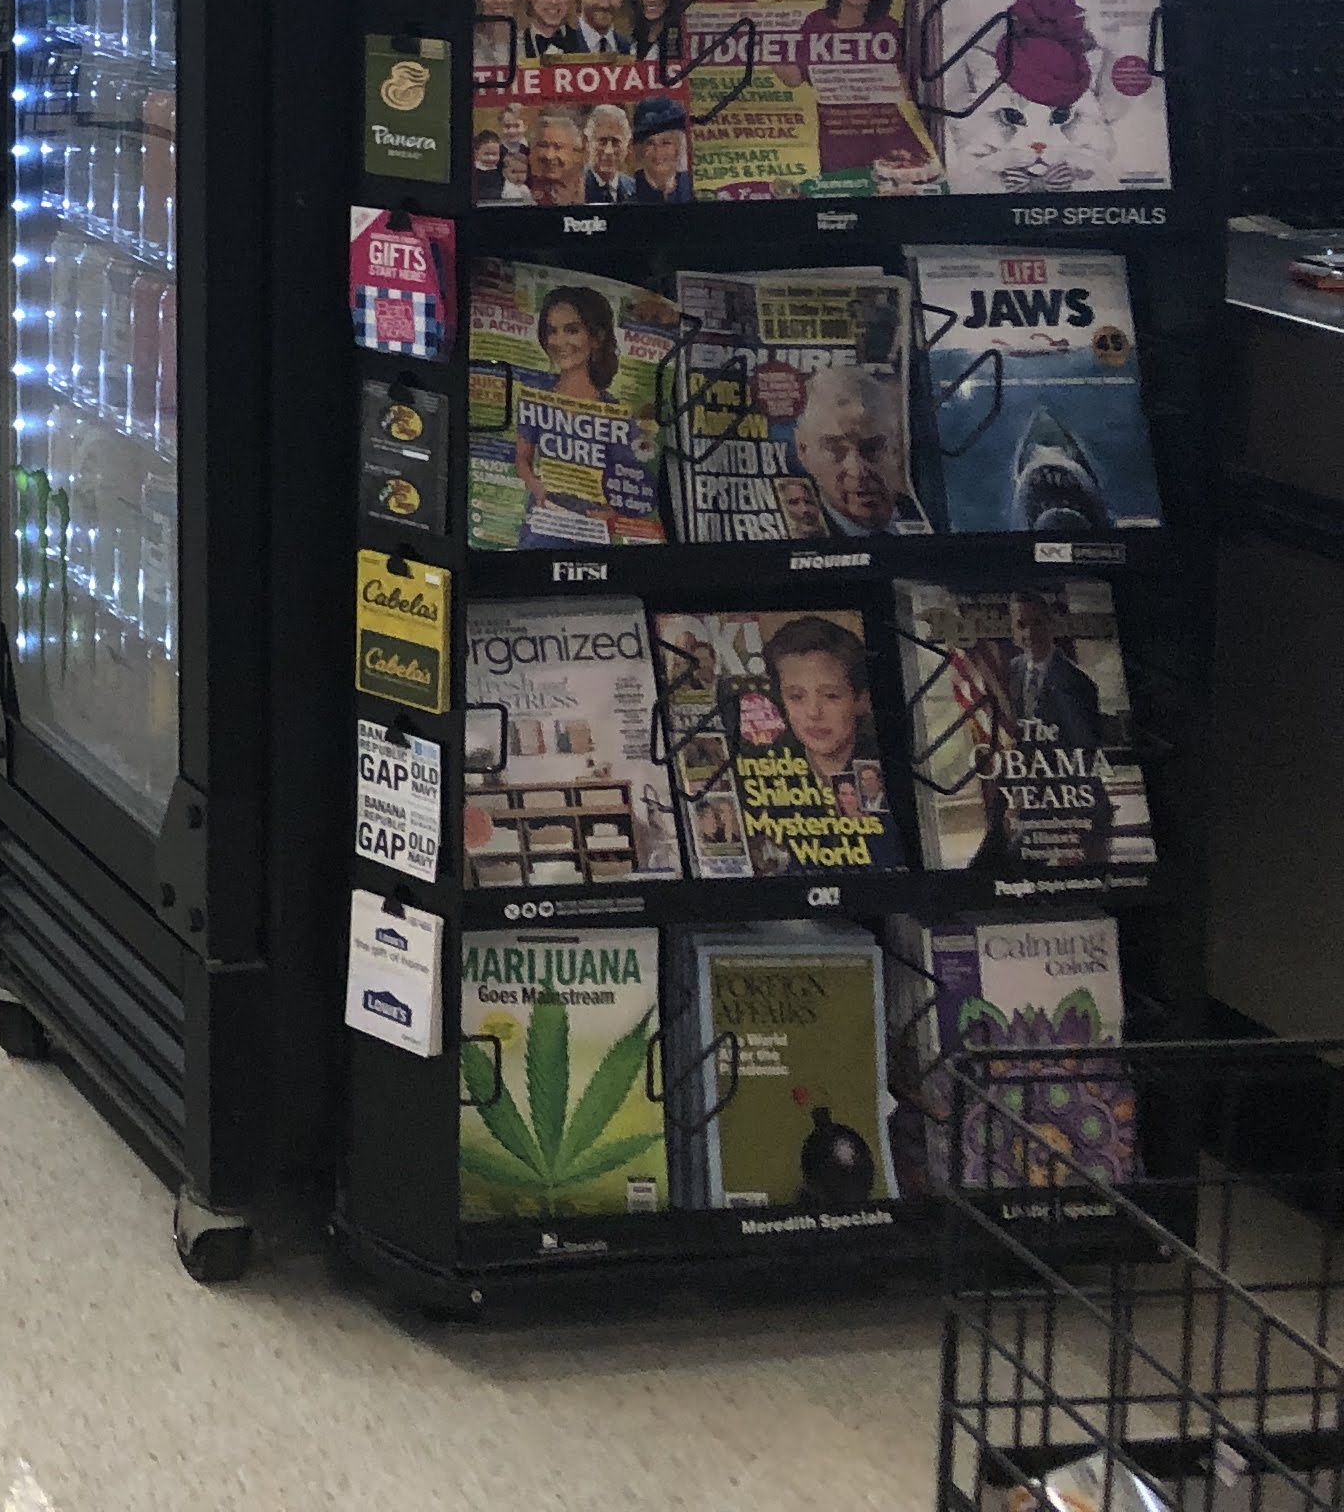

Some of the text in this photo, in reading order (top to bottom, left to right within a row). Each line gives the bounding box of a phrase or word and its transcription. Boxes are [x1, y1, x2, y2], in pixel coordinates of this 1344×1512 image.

[810, 31, 898, 61] KETO
[553, 64, 685, 92] ROYALS
[371, 124, 437, 151] Panera
[724, 126, 798, 140] PROZAC
[756, 162, 808, 178] FALLS
[563, 215, 608, 236] People
[1012, 206, 1167, 227] TISP SPECIALS
[368, 240, 428, 272] GIFTS
[1000, 258, 1048, 284] LIFE
[962, 287, 1096, 329] JAWS
[518, 401, 631, 446] HUNGER
[539, 432, 607, 469] CURE
[551, 561, 608, 582] First
[1017, 717, 1060, 743] The
[360, 752, 439, 791] GAP OLD
[736, 747, 810, 777] Inside
[969, 743, 1116, 781] OBAMA
[411, 778, 439, 800] NAVY
[745, 777, 837, 807] Shiloh's
[998, 784, 1097, 810] YEARS
[364, 794, 407, 820] BANANA
[745, 808, 885, 845] Mysterious
[358, 821, 437, 861] GAP OLD
[789, 836, 872, 866] World
[408, 849, 434, 870] NAVY
[478, 986, 616, 1006] Goes Mainstream
